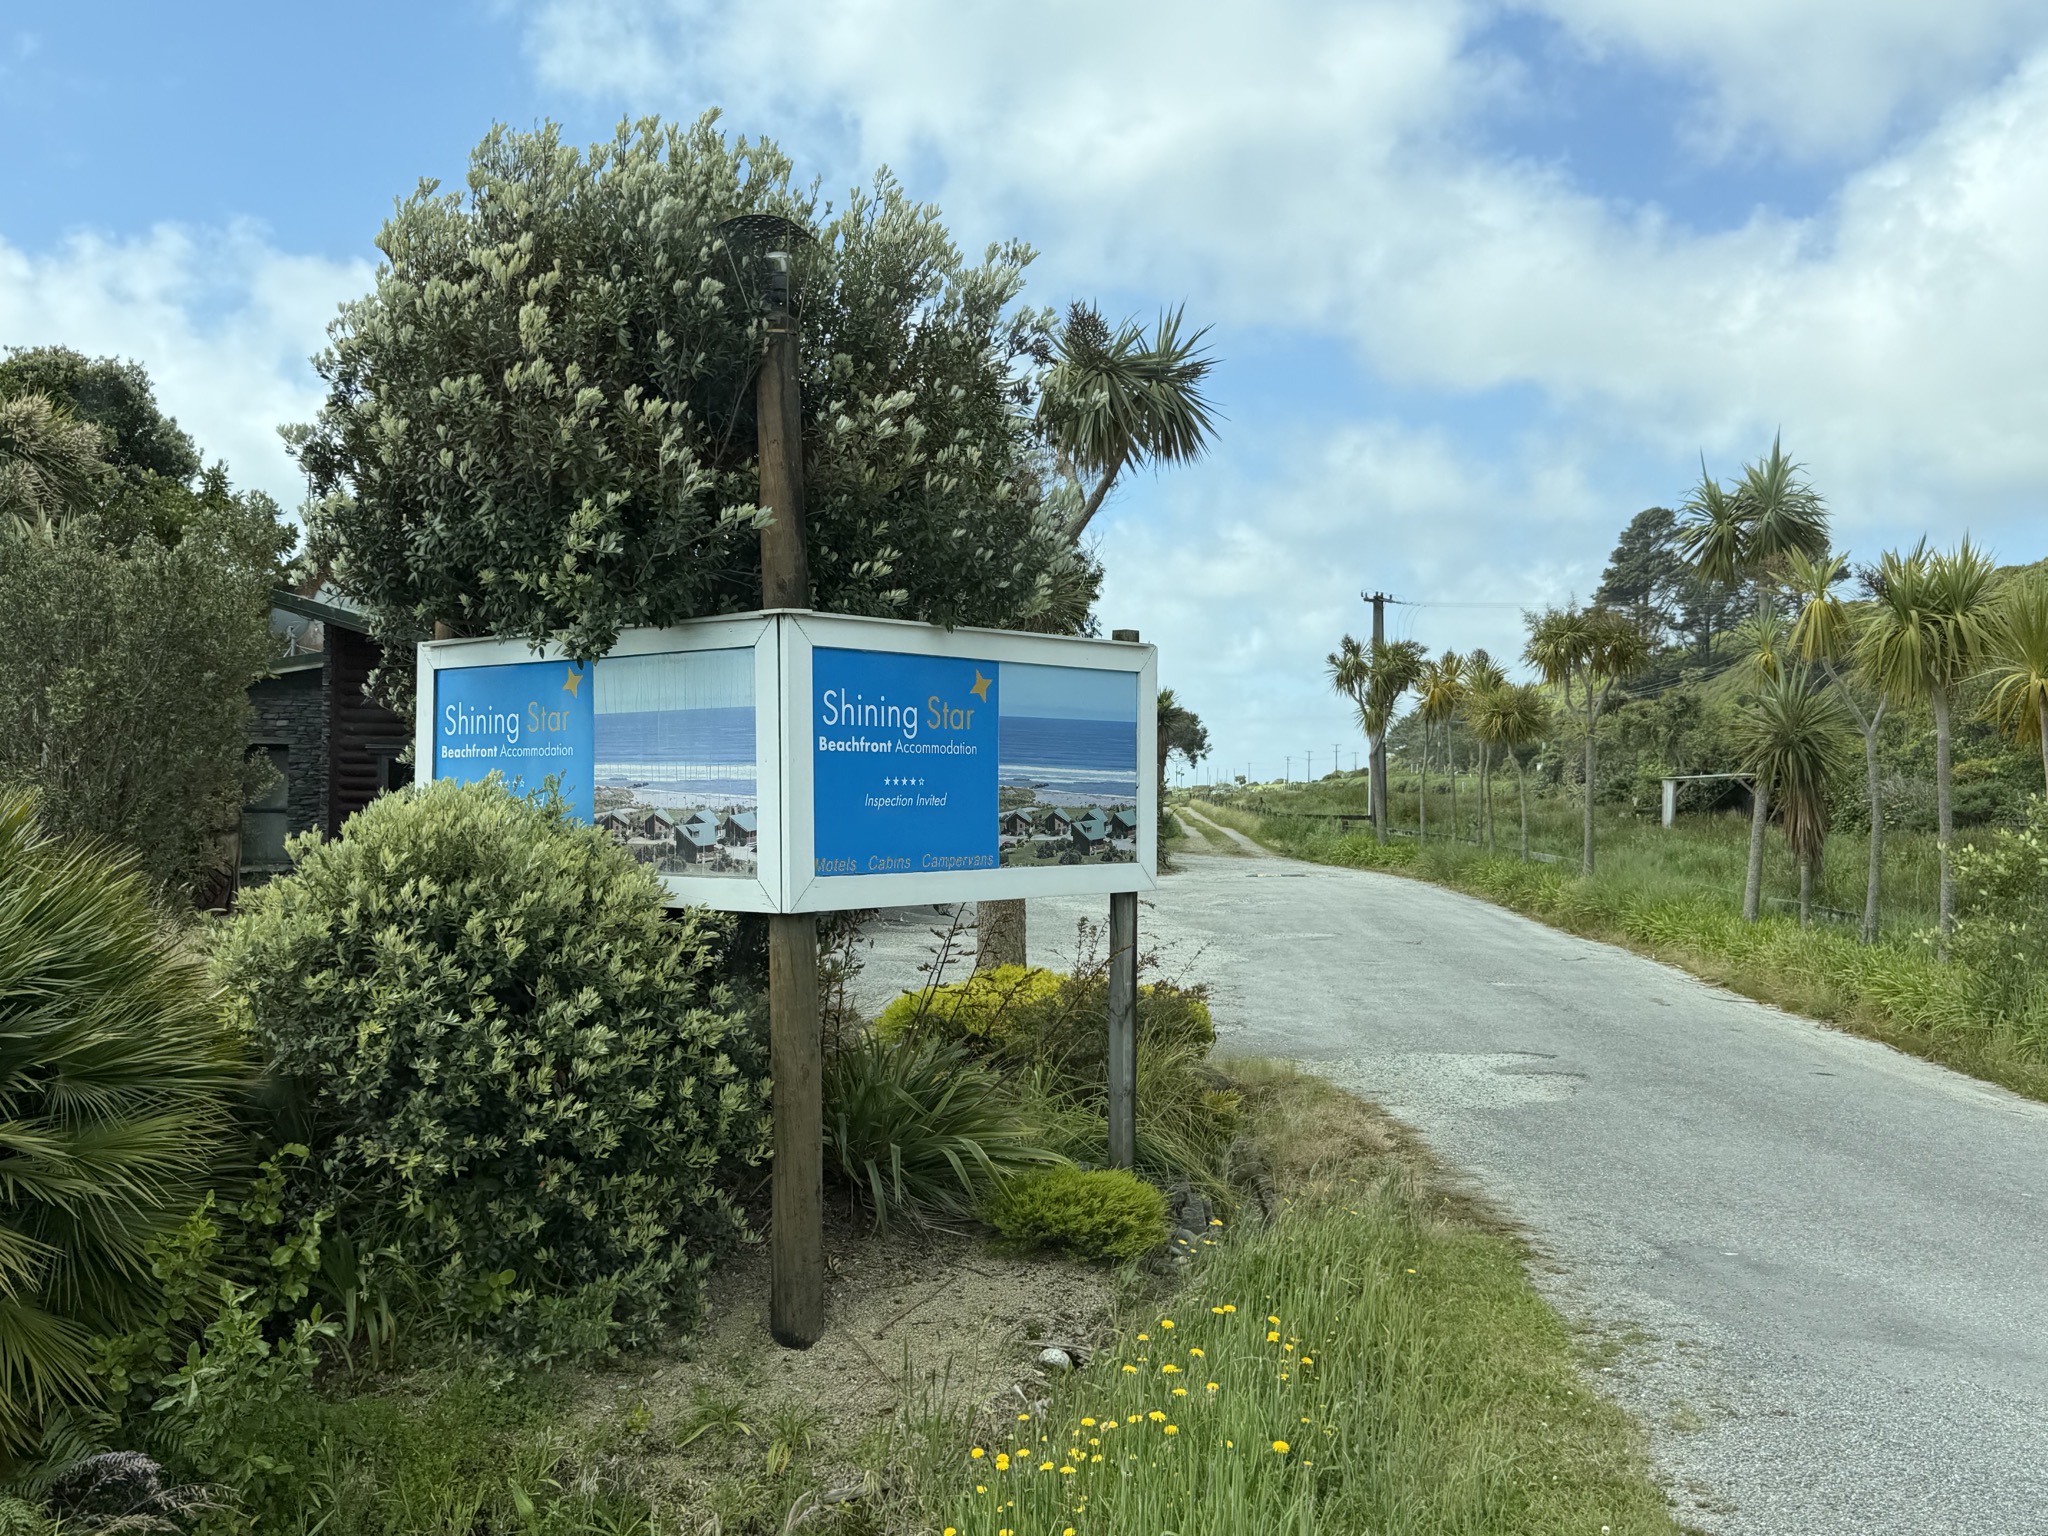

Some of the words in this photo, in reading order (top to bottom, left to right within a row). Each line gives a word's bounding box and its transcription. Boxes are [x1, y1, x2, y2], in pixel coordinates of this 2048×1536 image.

[444, 702, 520, 744] Shining
[527, 701, 571, 733] Star
[822, 688, 918, 739] Shining
[926, 695, 976, 731] Star
[441, 744, 498, 759] Beachfront
[499, 742, 574, 758] Accommodation
[818, 736, 892, 754] Beachfront
[895, 738, 978, 756] Accommodation
[865, 792, 914, 810] Inspection
[916, 791, 948, 807] Invited
[867, 855, 912, 871] Cabins
[922, 853, 994, 870] Campervans
